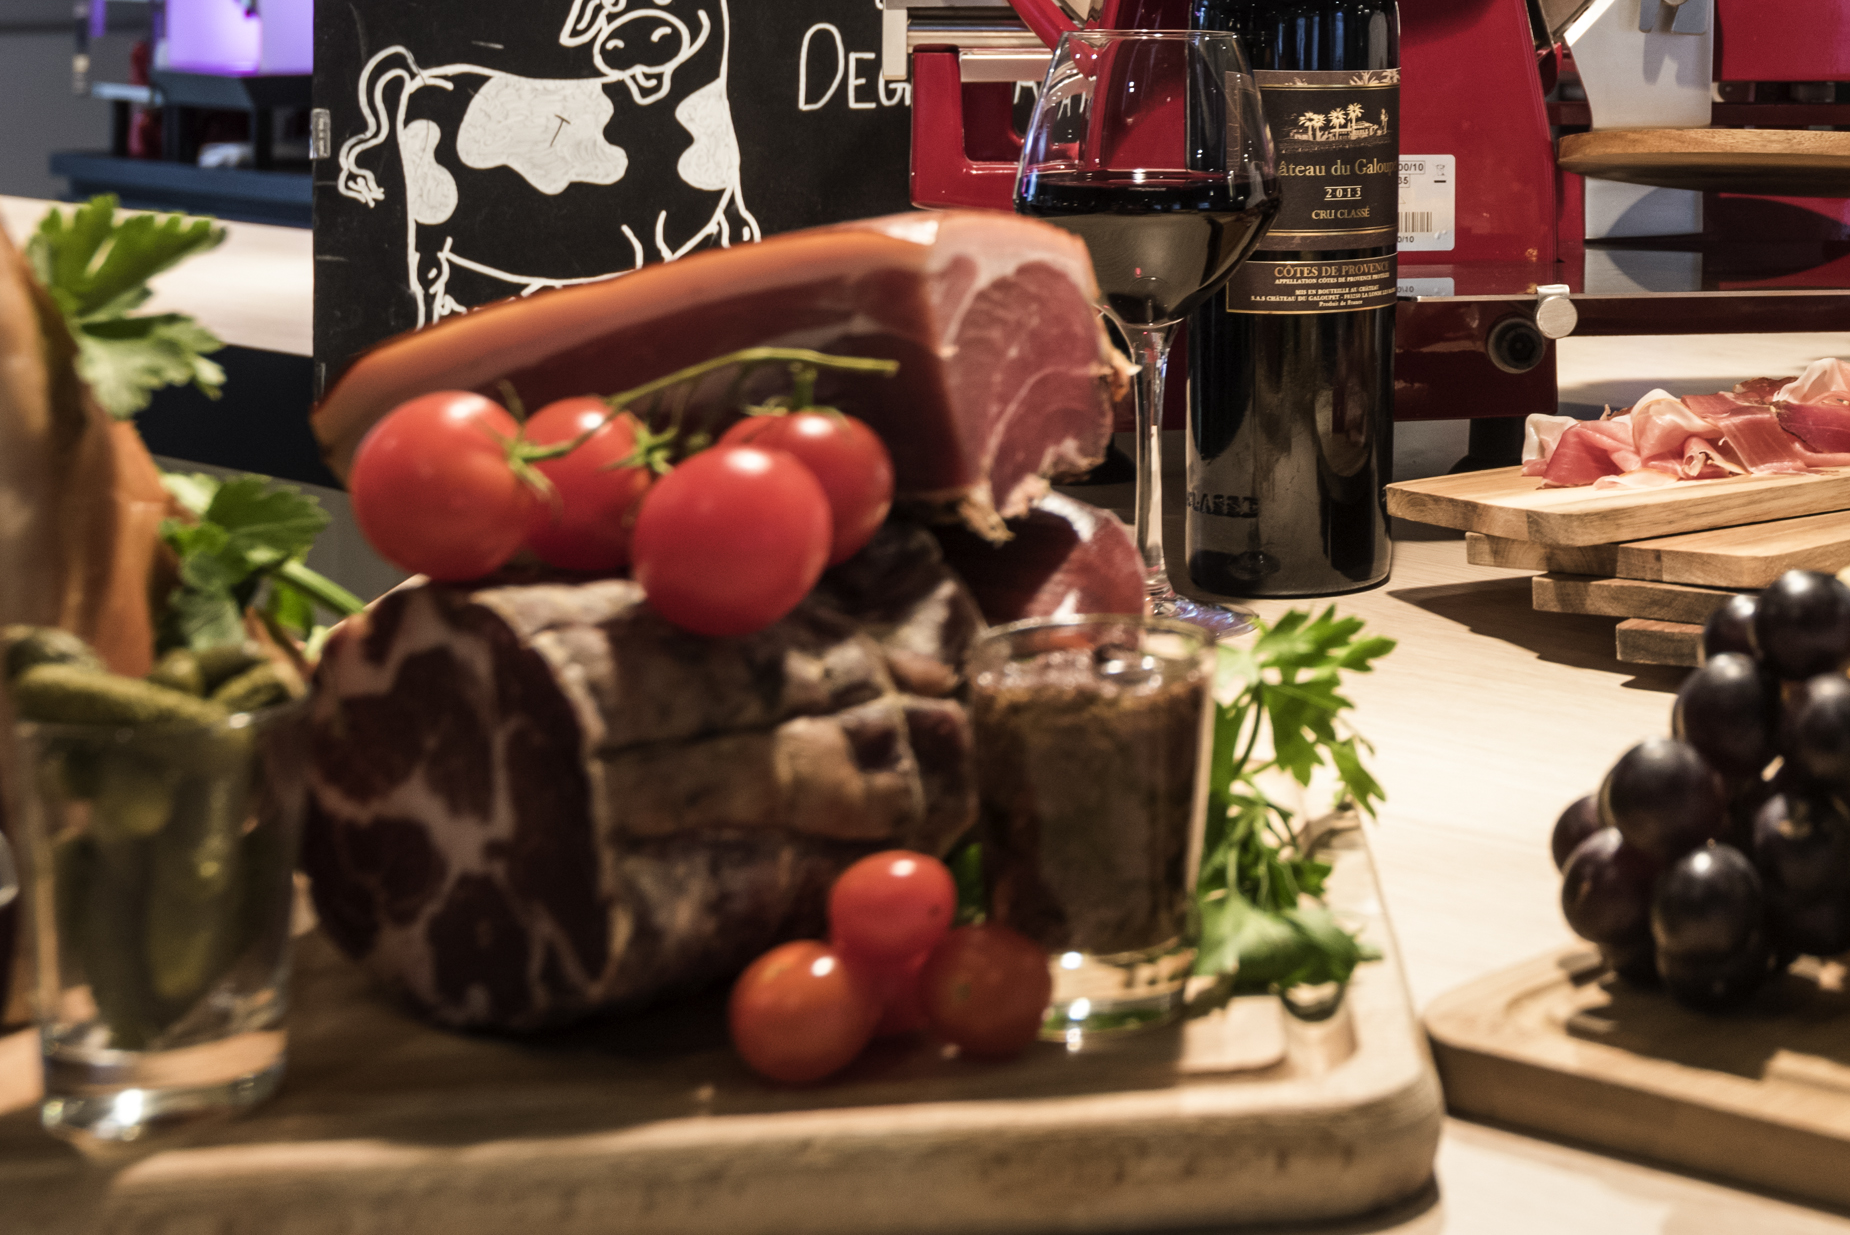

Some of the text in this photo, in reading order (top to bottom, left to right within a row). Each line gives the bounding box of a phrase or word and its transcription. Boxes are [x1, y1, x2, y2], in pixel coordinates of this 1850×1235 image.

[1331, 159, 1351, 176] du
[1311, 205, 1371, 220] CRU CLASSÉ
[1273, 264, 1319, 277] CÔTES
[1321, 266, 1339, 277] DE
